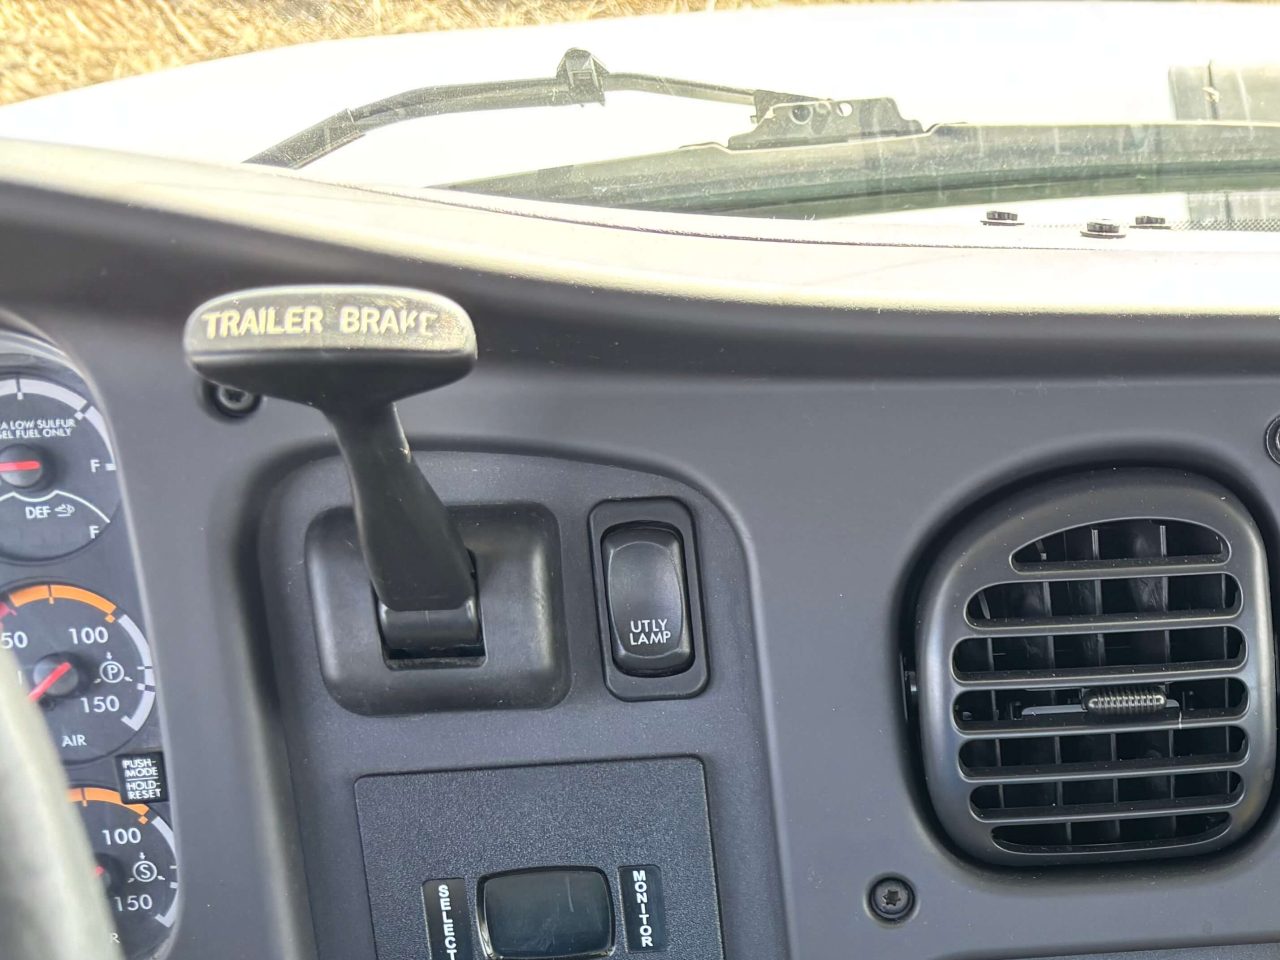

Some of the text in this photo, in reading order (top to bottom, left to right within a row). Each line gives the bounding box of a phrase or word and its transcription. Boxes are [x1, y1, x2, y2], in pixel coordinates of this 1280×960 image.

[202, 306, 438, 339] TRAILER BRAKE
[10, 420, 35, 430] LOW
[37, 418, 76, 428] SULFUR
[16, 429, 41, 438] FUEL
[42, 427, 73, 437] ONLY
[90, 459, 101, 473] F
[25, 505, 52, 519] DEF
[88, 525, 100, 539] F
[630, 618, 668, 632] UTLY
[69, 626, 109, 645] 100
[629, 630, 671, 646] LAMP
[80, 695, 120, 714] 150
[61, 734, 88, 748] AIR
[125, 767, 159, 778] MODE
[128, 788, 161, 800] RESET
[101, 827, 142, 846] 100
[115, 894, 153, 912] 150
[632, 870, 653, 947] MONITOR
